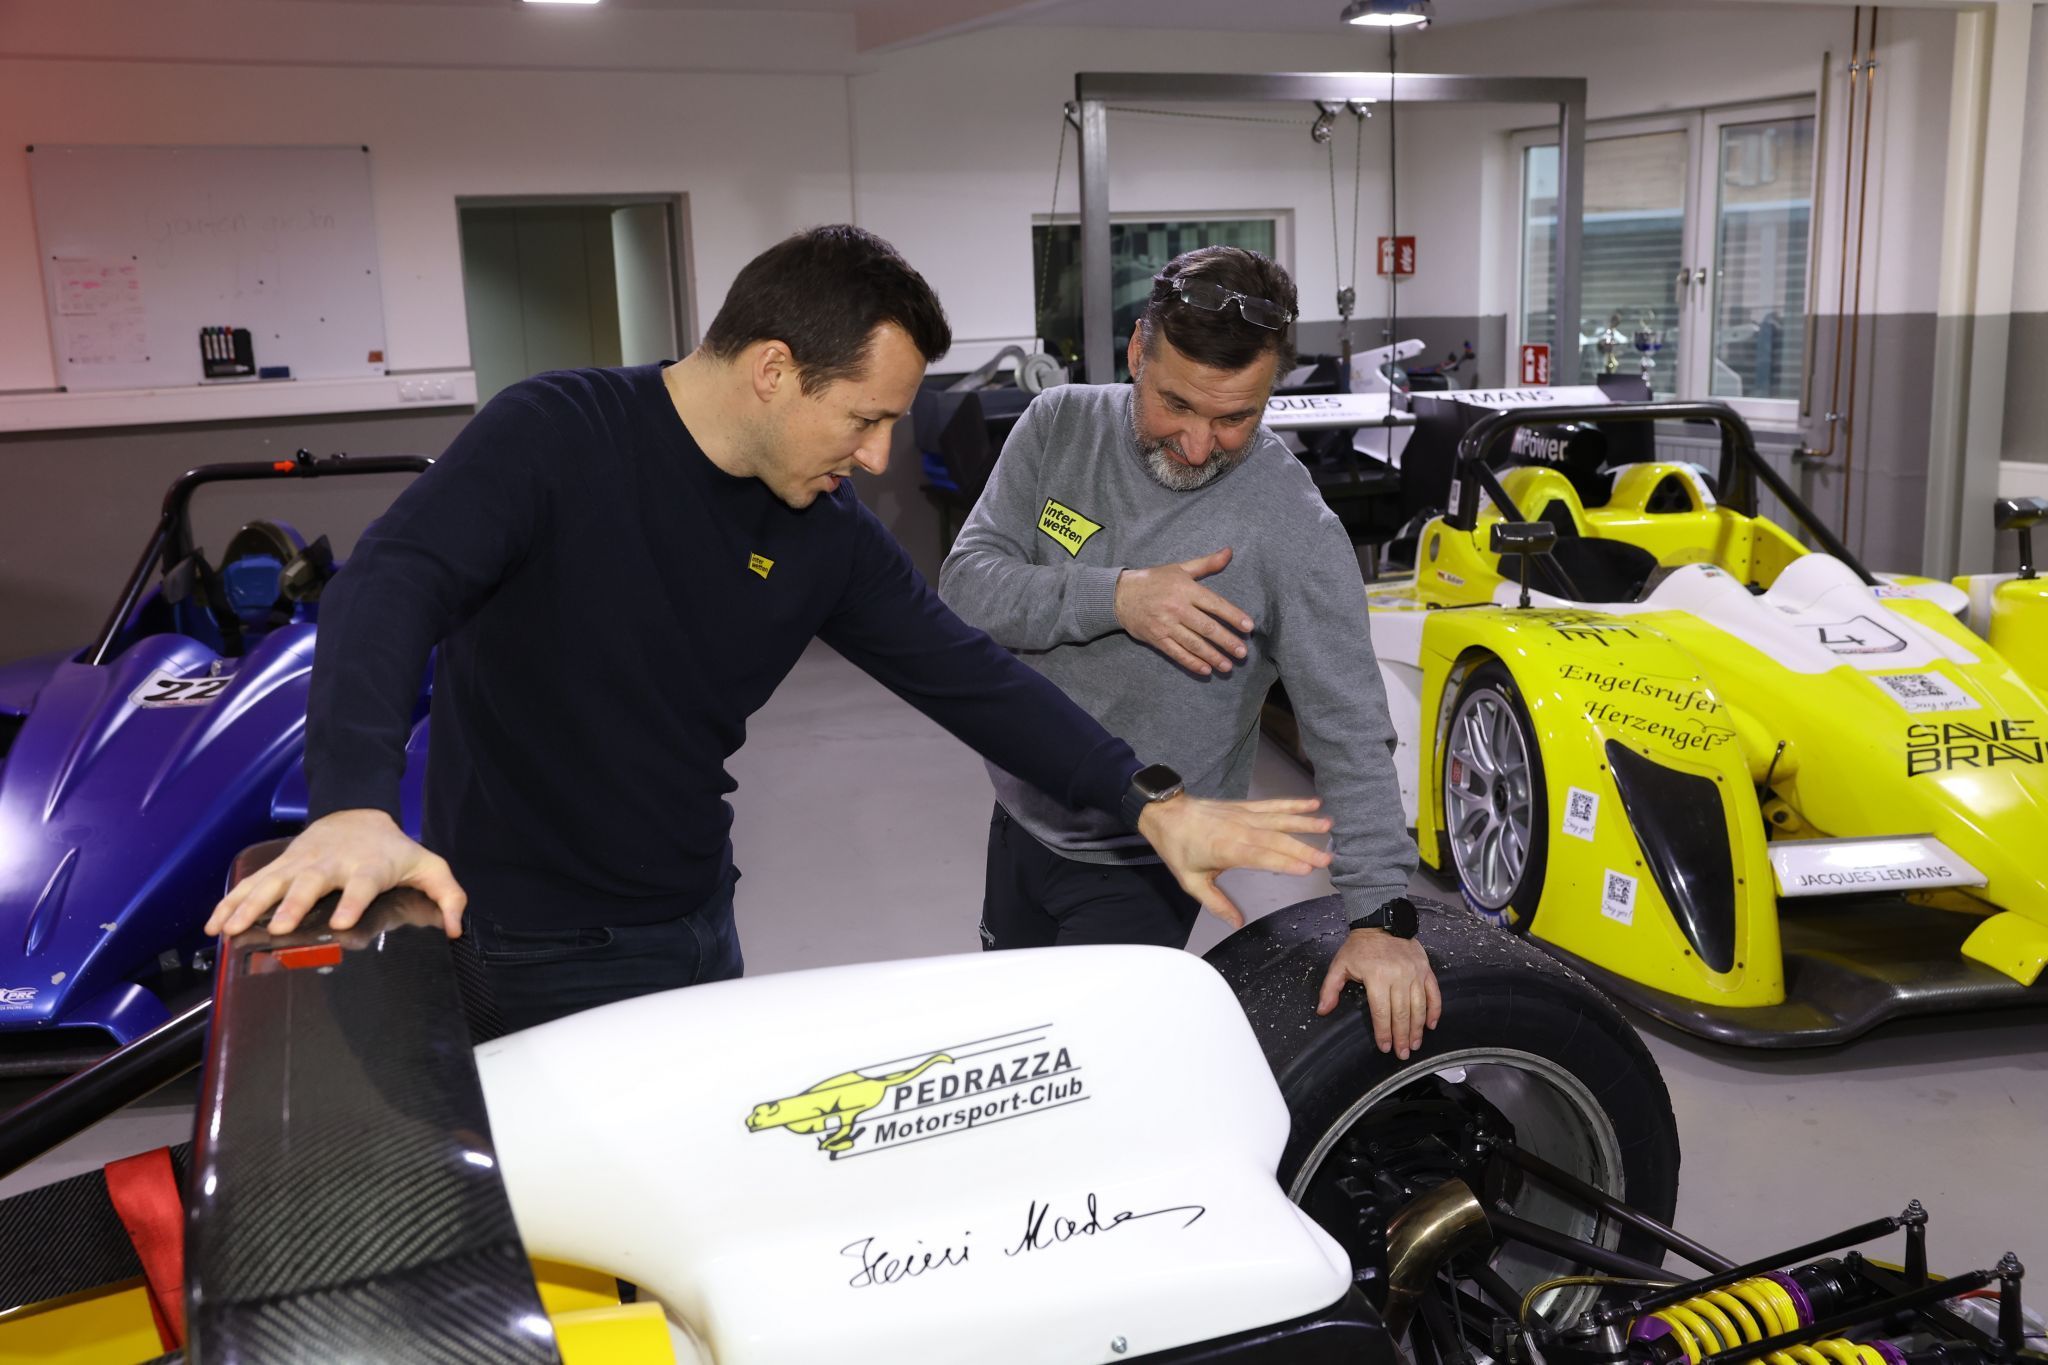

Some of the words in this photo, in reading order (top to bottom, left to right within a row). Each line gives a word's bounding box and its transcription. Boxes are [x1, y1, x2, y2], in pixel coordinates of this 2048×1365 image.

[1268, 397, 1342, 411] QUES
[1045, 501, 1077, 526] inter
[1043, 517, 1083, 545] wetten
[1818, 627, 1866, 646] 4
[143, 679, 231, 702] 22
[1559, 664, 1723, 714] Engelsrufer
[1581, 700, 1717, 751] Herzengel
[1906, 719, 2040, 748] SAVE
[1907, 741, 2048, 777] BRAV
[1800, 869, 1876, 887] JACQUES
[1880, 865, 1952, 882] LEMANS
[893, 1047, 1073, 1111] PEDRAZZA
[874, 1076, 1084, 1144] Motorsport-Club
